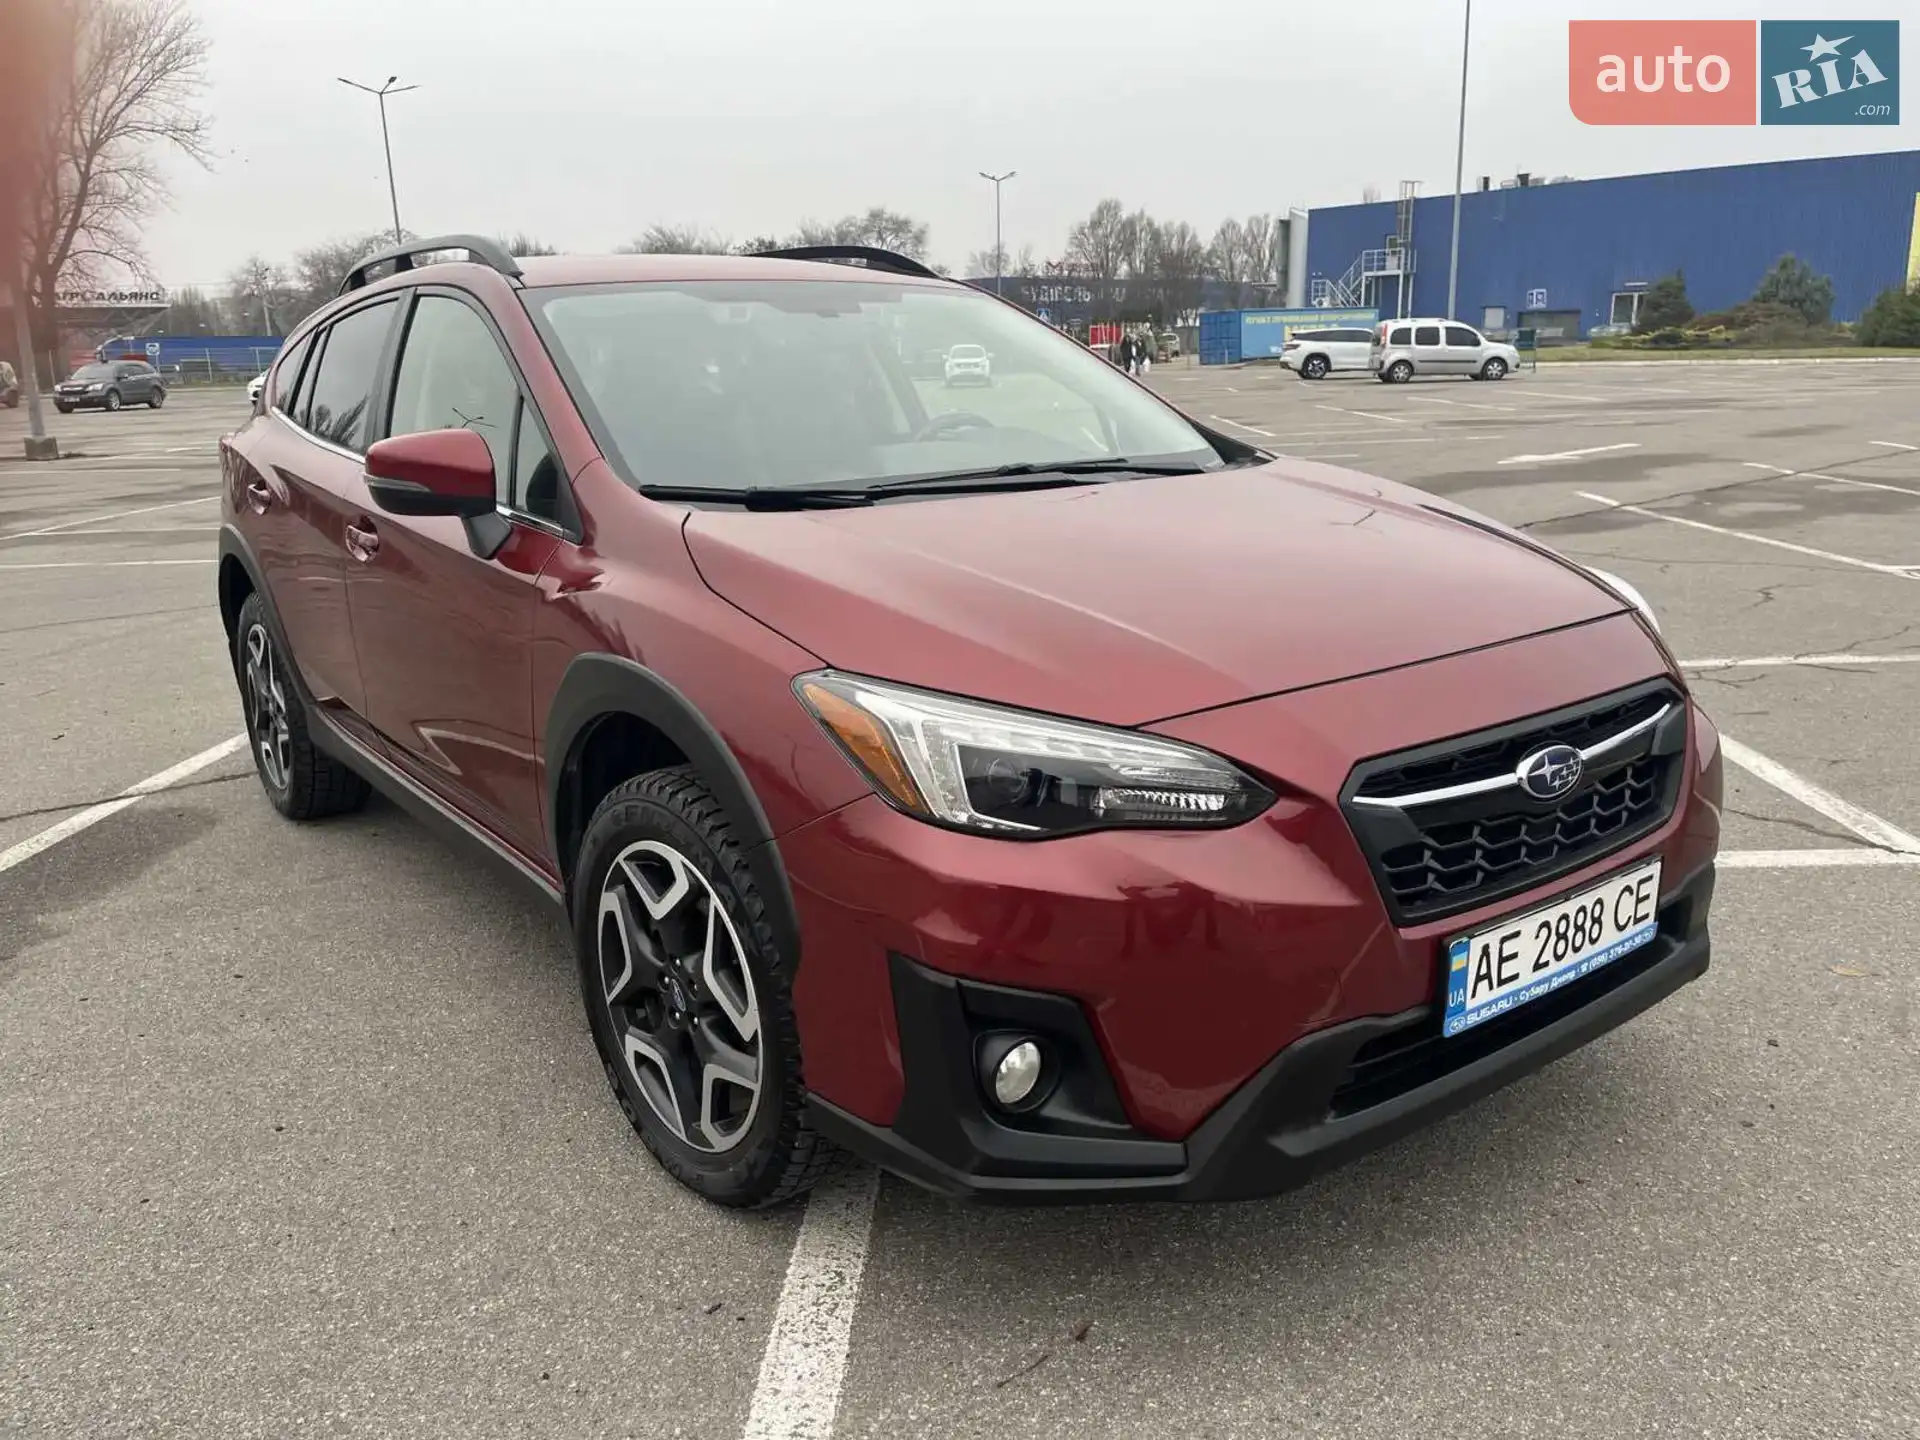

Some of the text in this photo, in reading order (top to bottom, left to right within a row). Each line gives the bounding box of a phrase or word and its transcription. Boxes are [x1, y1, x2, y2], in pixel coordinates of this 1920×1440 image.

[1470, 875, 1654, 1000] AE 2888 CE
[1449, 991, 1465, 1008] UA
[1467, 996, 1513, 1024] SUBARU
